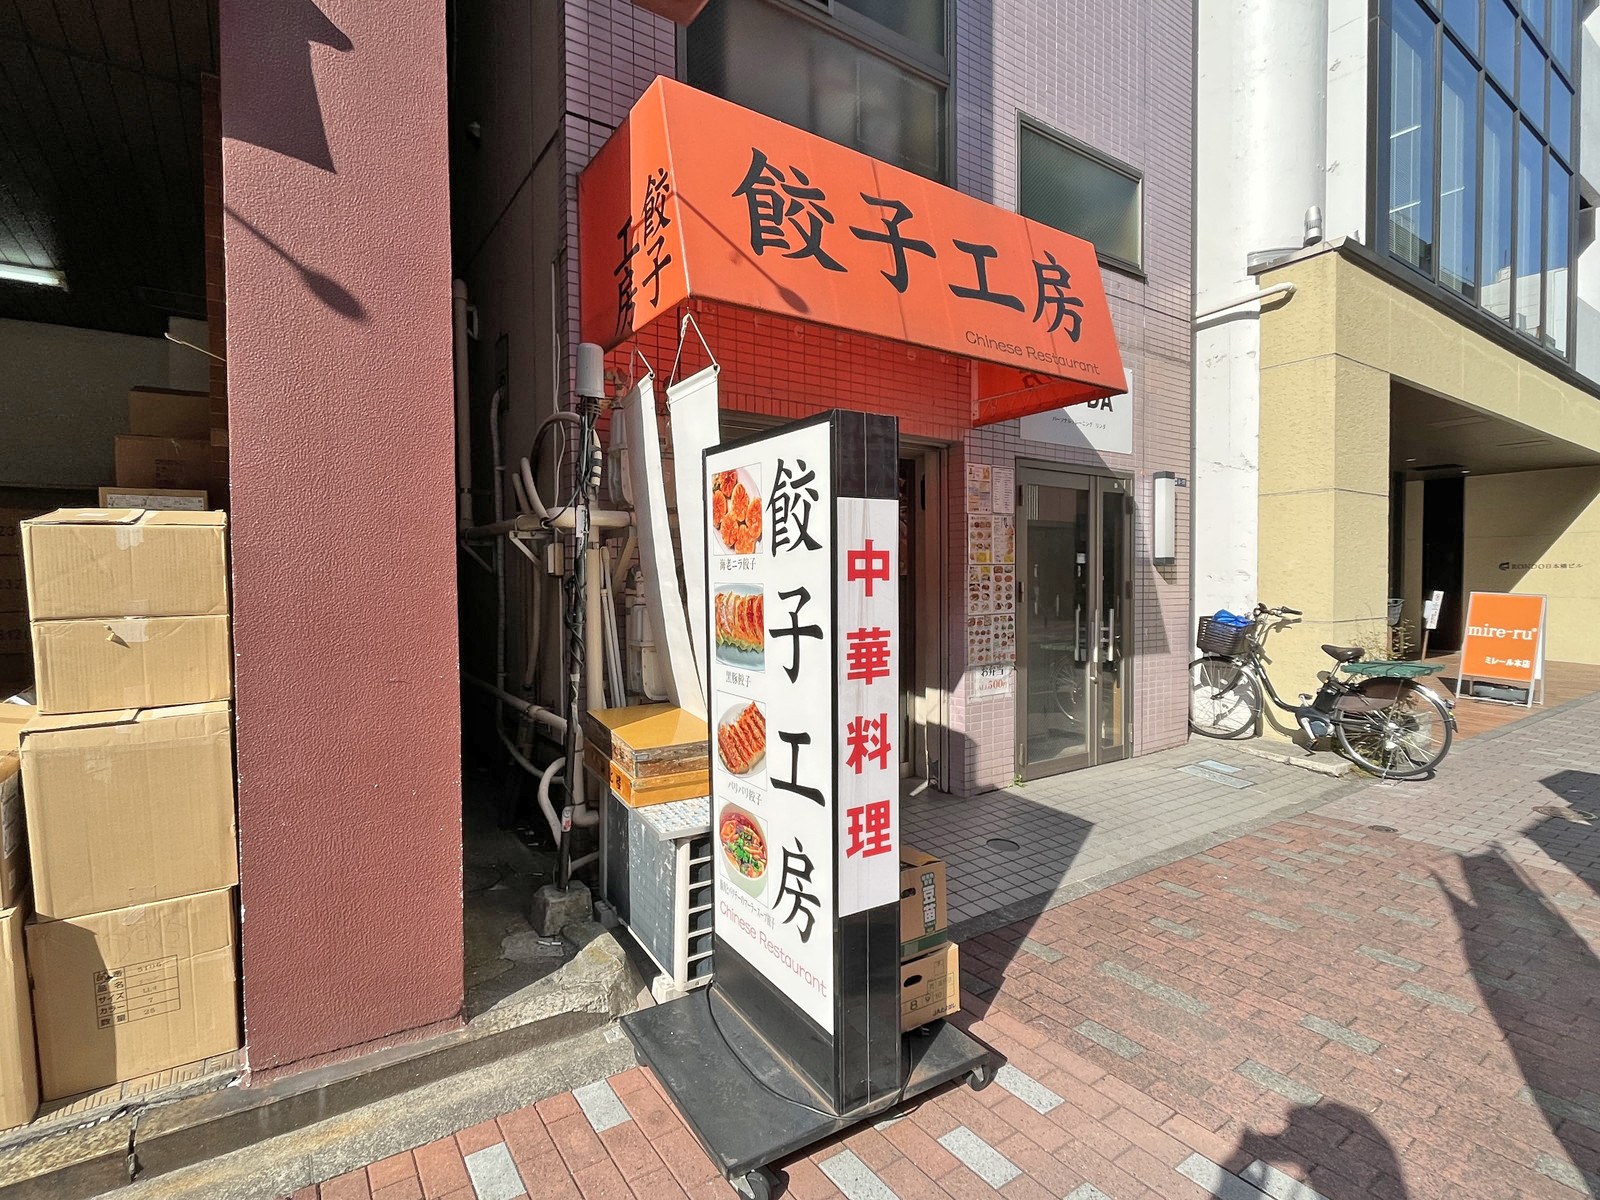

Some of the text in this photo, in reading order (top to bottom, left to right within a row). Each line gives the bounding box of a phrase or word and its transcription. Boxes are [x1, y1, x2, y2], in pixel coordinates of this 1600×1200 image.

[641, 167, 671, 308] 餃子
[732, 147, 1084, 342] 餃子工房
[613, 215, 640, 337] 工房
[965, 330, 1100, 375] Chinese Restaurant
[719, 557, 756, 571] 海老ニラ餃子
[1467, 623, 1533, 640] mire-ru
[1484, 656, 1531, 669] ミレール本店
[766, 458, 825, 943] 餃子工房
[846, 539, 892, 859] 中華料理
[719, 900, 827, 998] Chinese Restaurant
[99, 991, 124, 1004] サイズ
[100, 1004, 125, 1015] カラー
